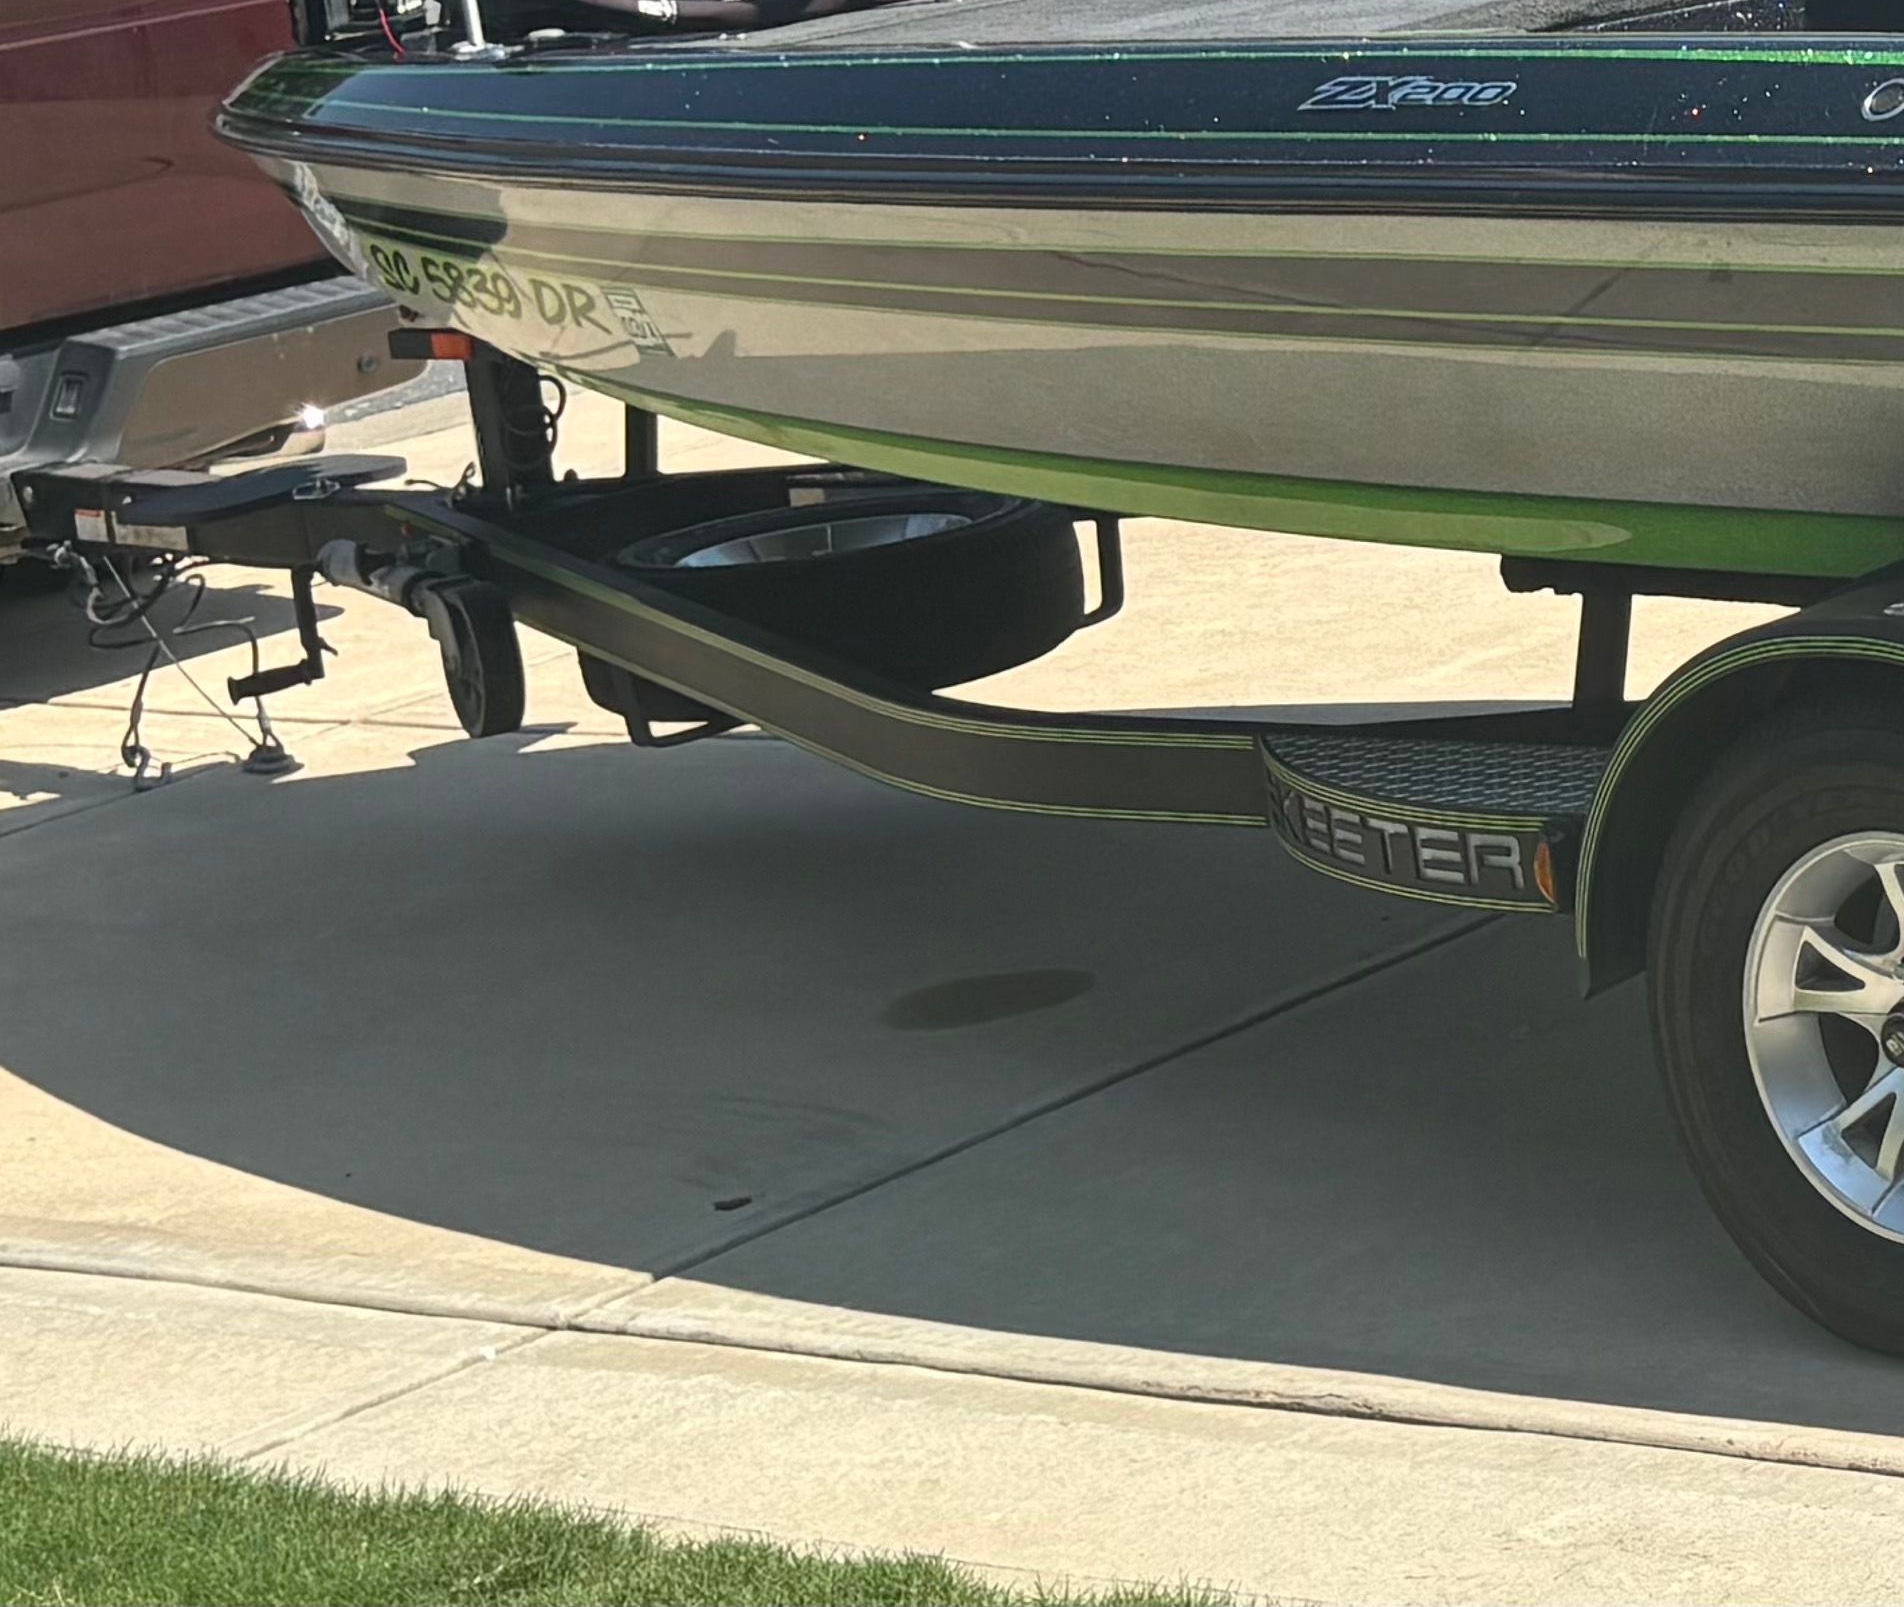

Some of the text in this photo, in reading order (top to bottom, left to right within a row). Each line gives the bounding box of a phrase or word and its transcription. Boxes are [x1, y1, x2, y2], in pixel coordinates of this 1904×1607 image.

[1297, 76, 1517, 110] ZX200
[369, 244, 421, 295] SC
[420, 255, 522, 320] 5839
[528, 278, 612, 335] DR
